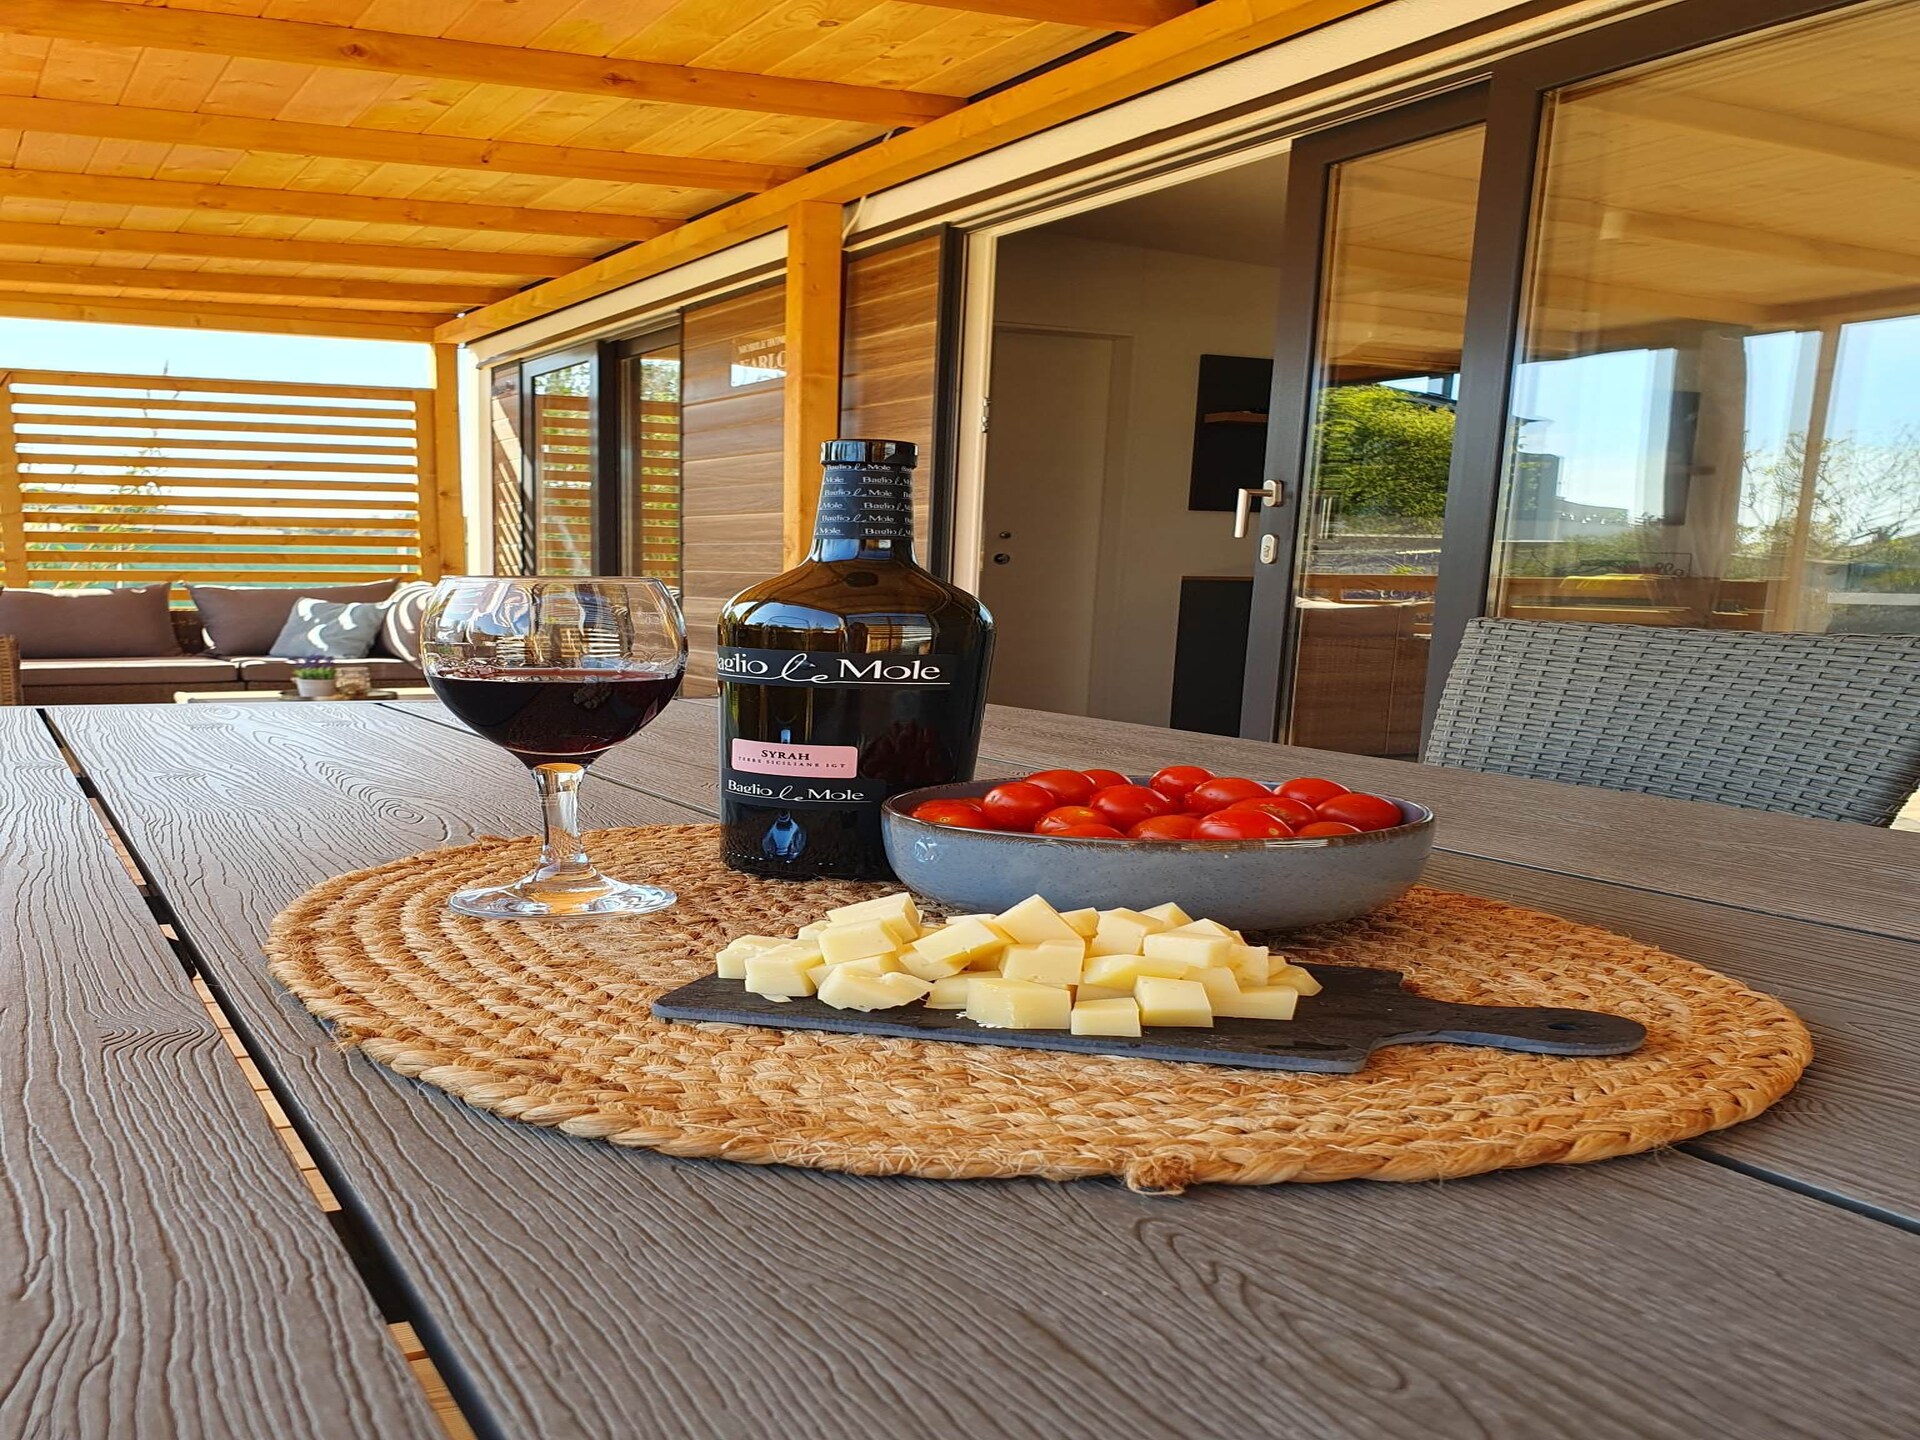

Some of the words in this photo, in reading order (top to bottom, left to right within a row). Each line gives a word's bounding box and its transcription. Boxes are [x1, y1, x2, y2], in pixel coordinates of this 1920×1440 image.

[867, 463, 891, 471] Mole
[862, 476, 893, 484] Baglio
[824, 489, 851, 497] Baglio
[868, 489, 893, 497] Mole
[836, 658, 941, 681] Mole
[761, 749, 810, 761] SYRAH
[766, 759, 820, 768] SICILIANE
[728, 779, 773, 796] Baglio
[808, 788, 865, 801] Mole
